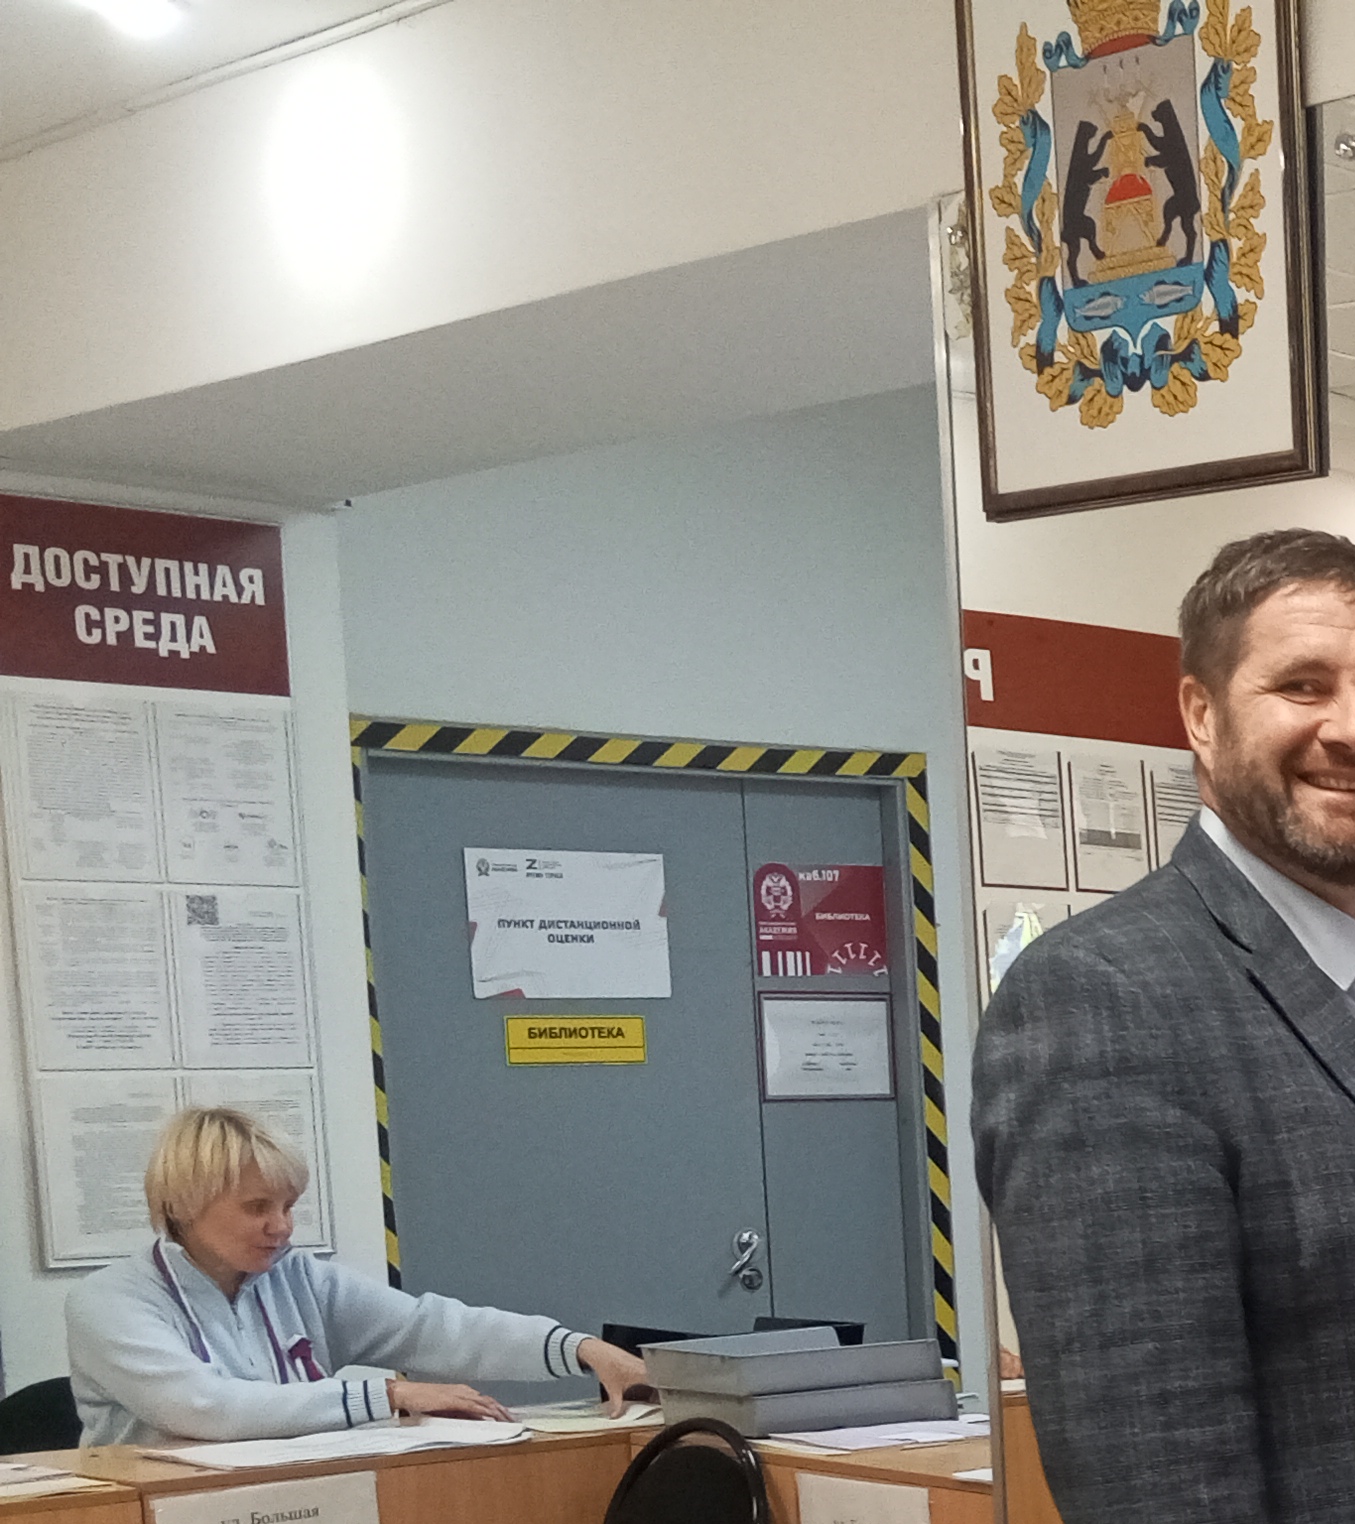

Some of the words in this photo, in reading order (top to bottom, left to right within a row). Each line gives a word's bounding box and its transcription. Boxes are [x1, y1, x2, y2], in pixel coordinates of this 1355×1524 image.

[10, 543, 266, 606] ДОСТУПНАЯ
[74, 604, 217, 660] СРЕДА
[815, 912, 871, 922] БИБЛИОТЕКА
[497, 918, 535, 930] ПУНКТ
[538, 918, 641, 931] ДИСТАНЦИОННОЙ
[547, 933, 595, 944] ОЦЕНКИ
[527, 1026, 626, 1040] БИБЛИОТЕКА
